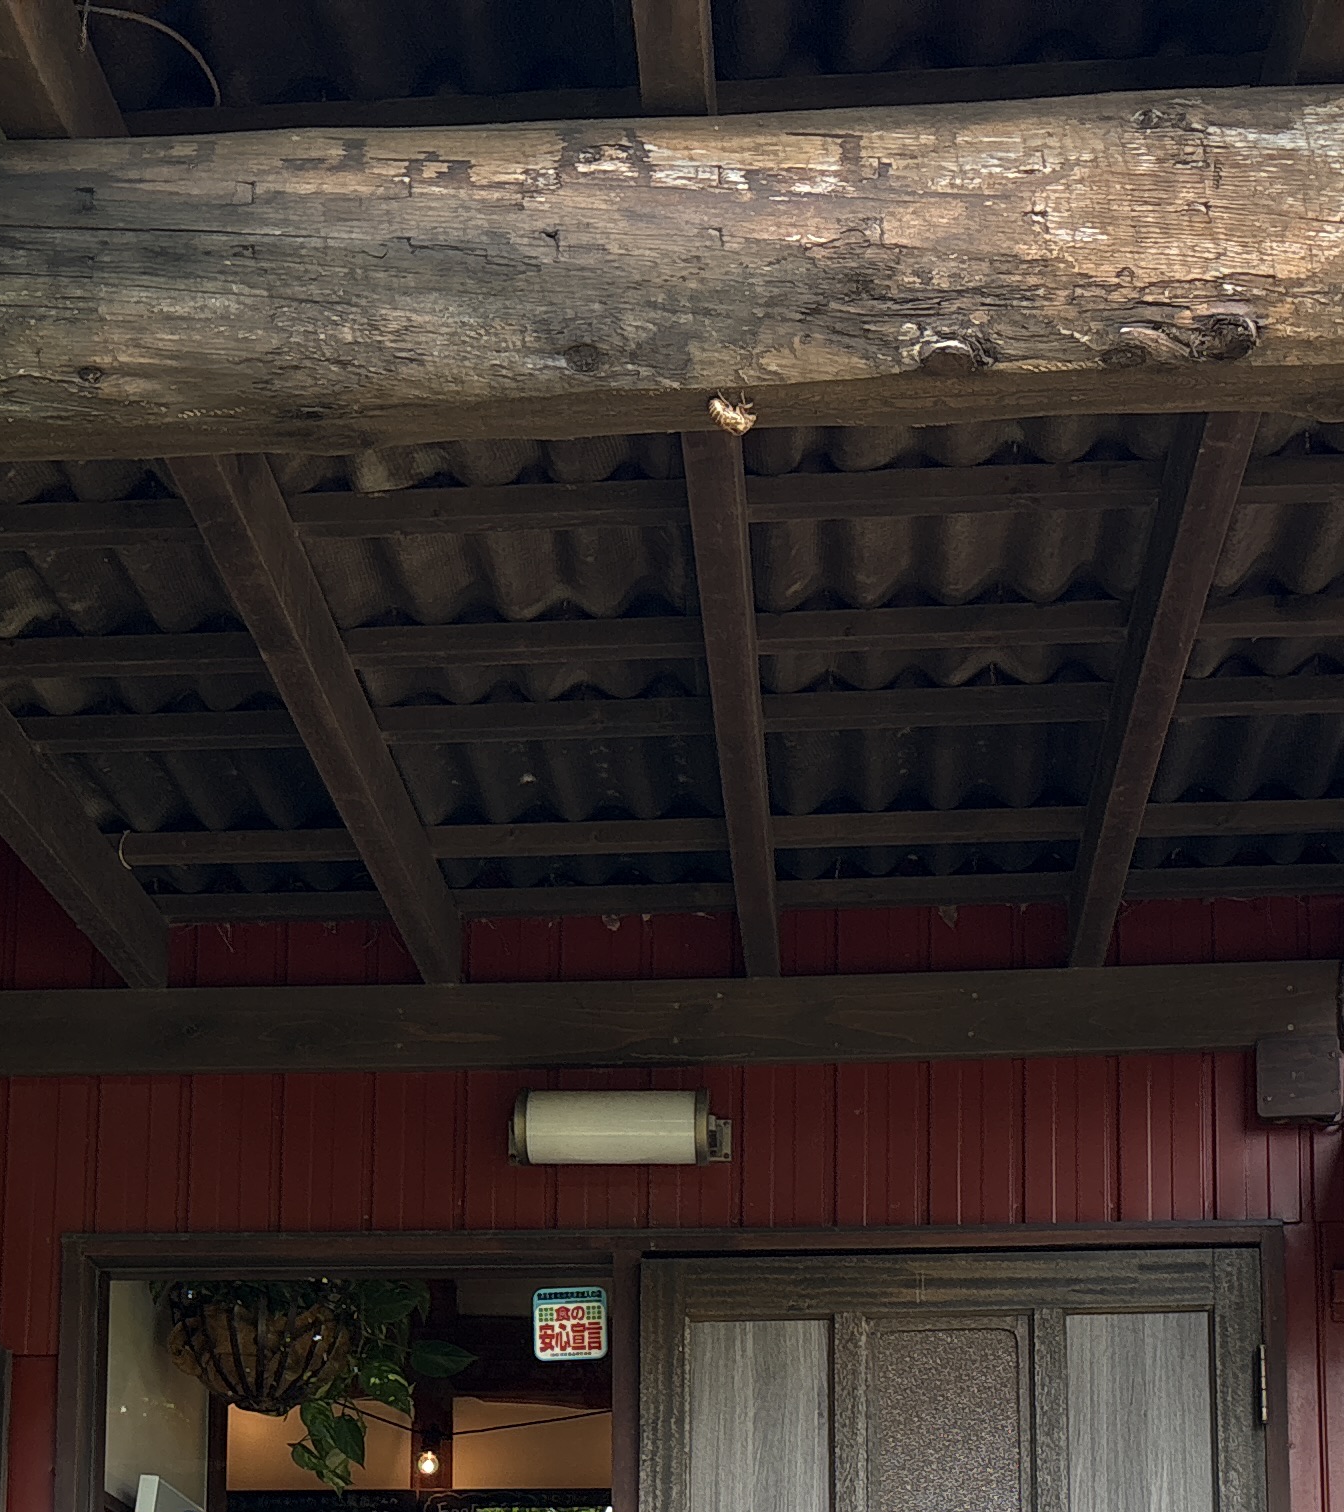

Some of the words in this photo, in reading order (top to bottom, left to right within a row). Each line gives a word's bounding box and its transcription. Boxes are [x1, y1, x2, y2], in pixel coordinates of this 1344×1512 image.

[555, 1306, 585, 1322] 食の
[539, 1322, 603, 1353] 安心宣言
